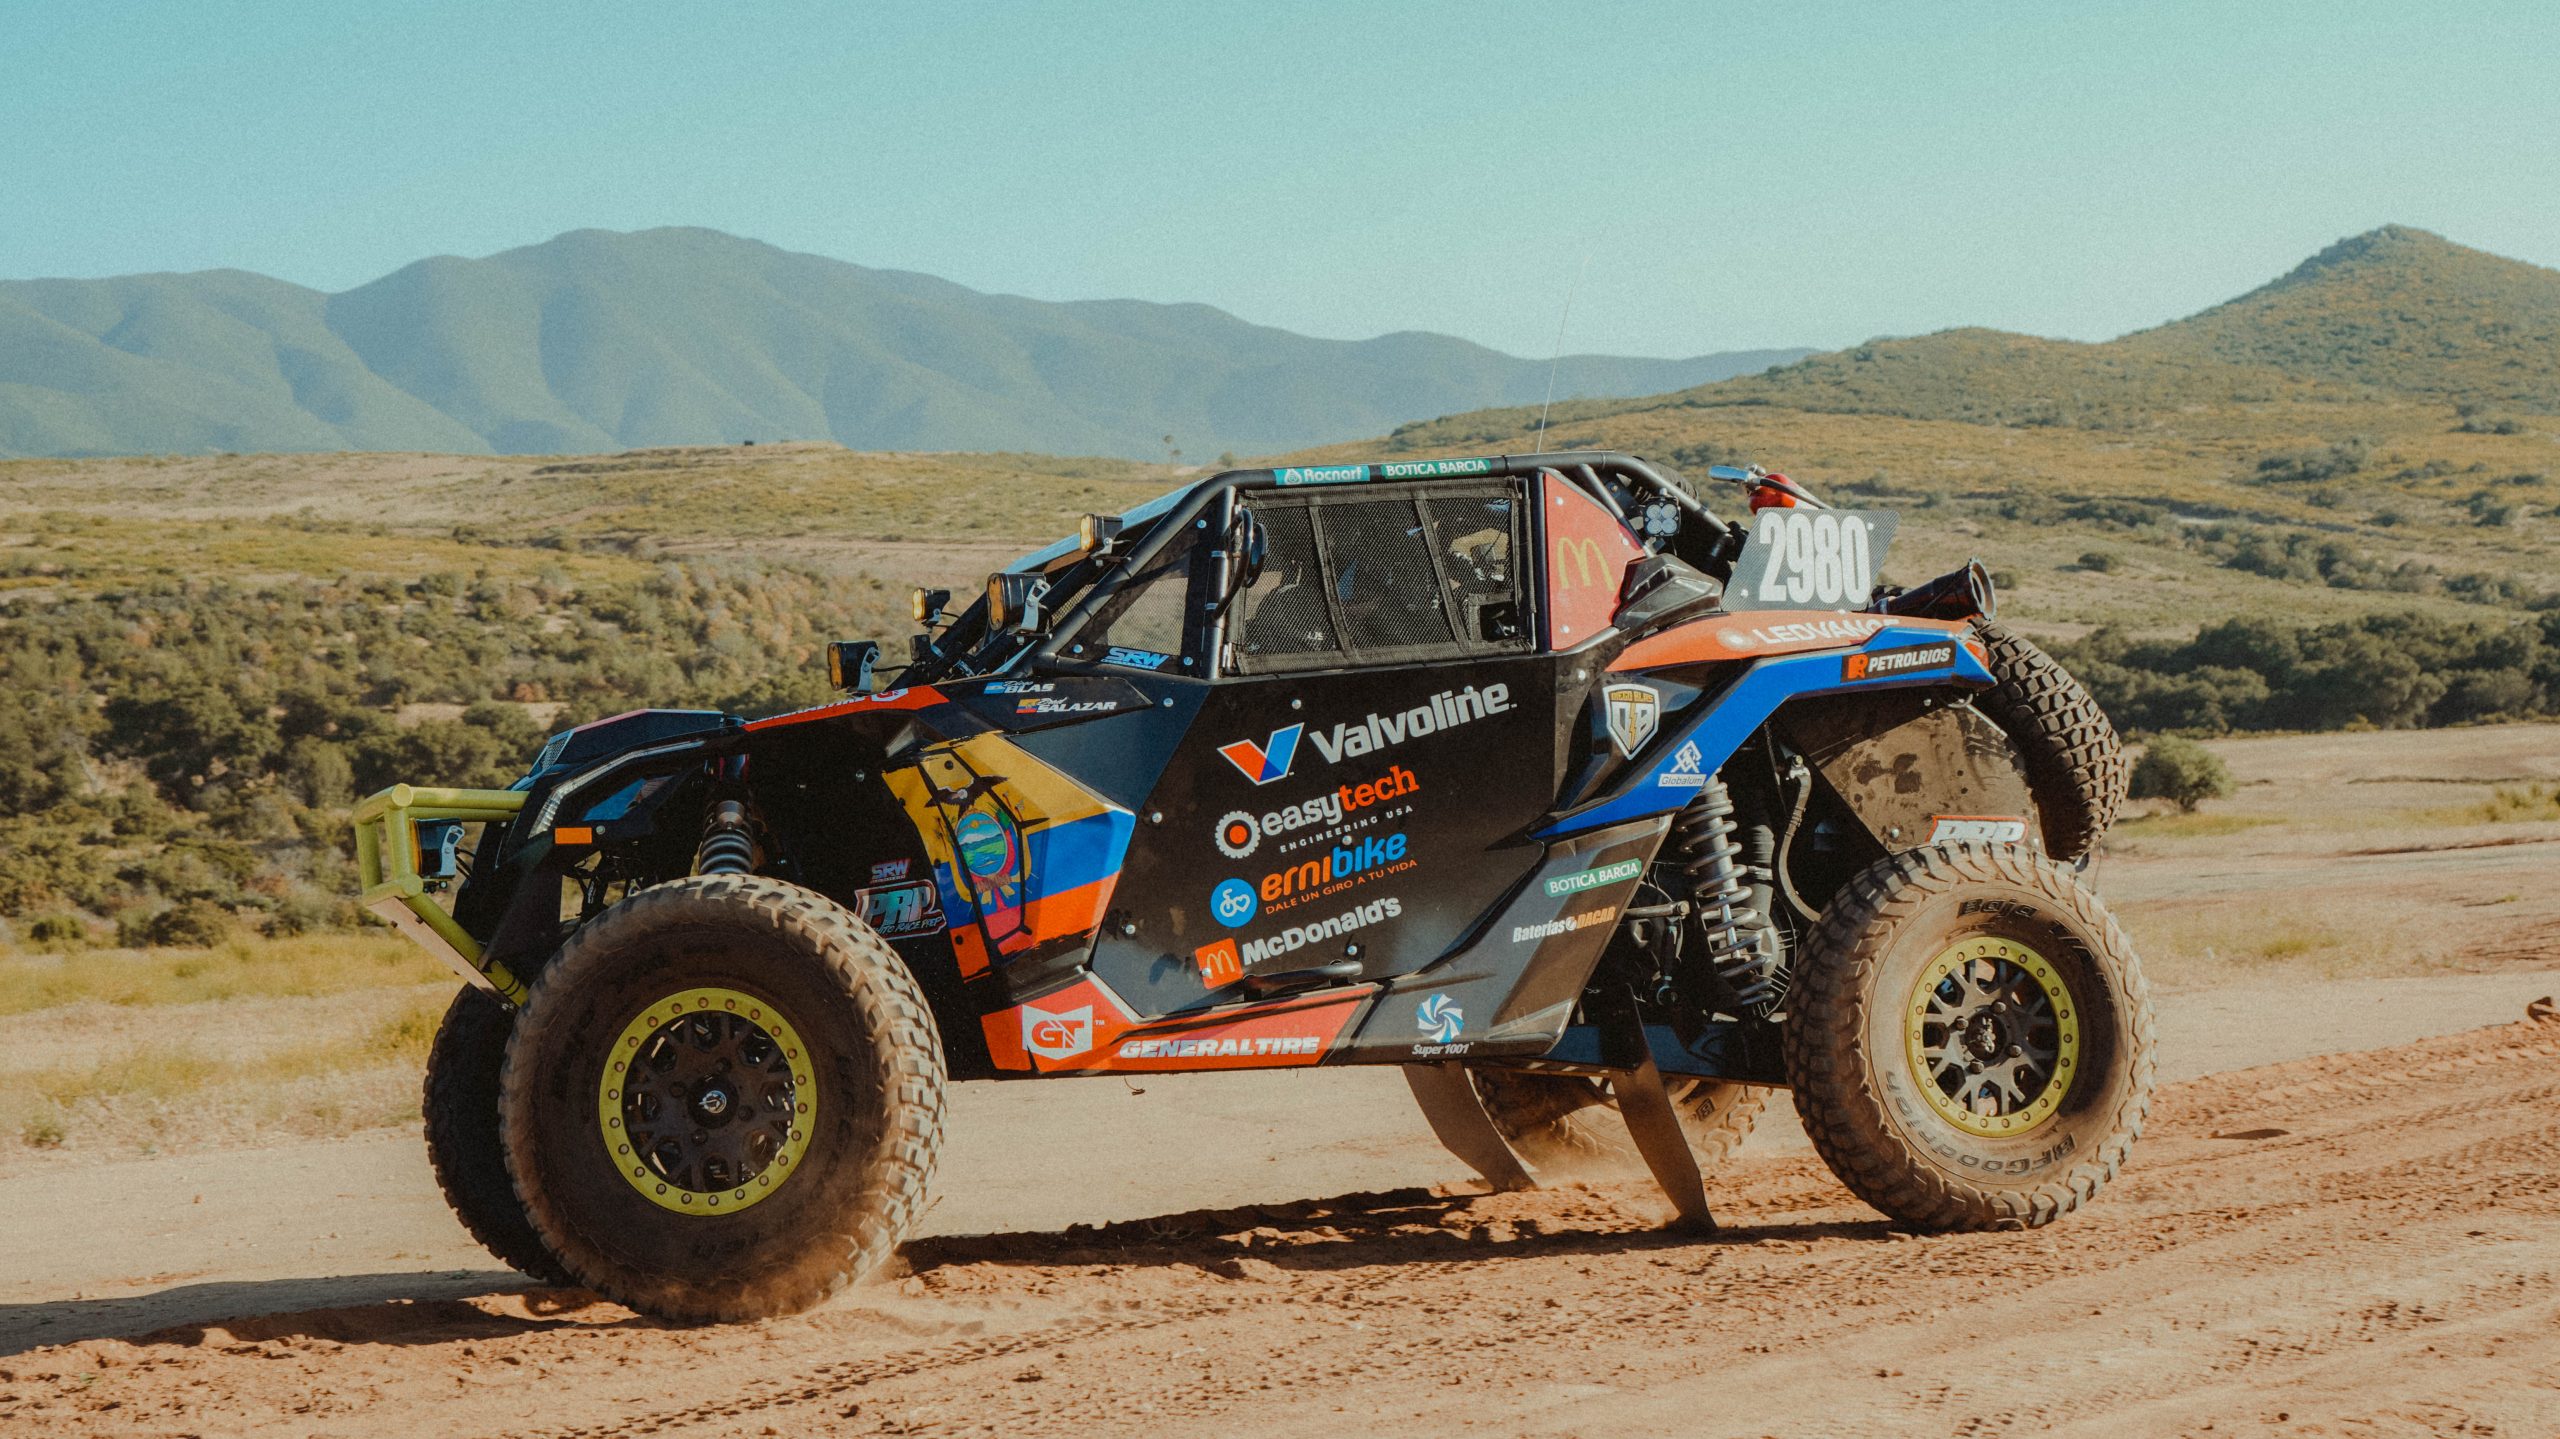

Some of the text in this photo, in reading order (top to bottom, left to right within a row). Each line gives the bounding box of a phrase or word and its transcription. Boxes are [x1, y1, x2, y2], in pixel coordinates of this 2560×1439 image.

[1386, 460, 1487, 477] BOTICA BARCIA
[1759, 511, 1871, 604] 2980
[1753, 618, 1900, 644] LEDVANC
[1868, 647, 1951, 673] PETROLRIOS
[1004, 683, 1056, 694] BLAS
[1037, 701, 1118, 713] SALAZAR
[1309, 682, 1509, 764] Valvoline
[1661, 776, 1703, 785] Globalum
[1261, 765, 1420, 836] easytech
[1280, 805, 1414, 853] ENGINEERING USA
[1266, 859, 1418, 915] DALE UN GIRO A TU VIDA
[1550, 862, 1639, 894] BOTICA BARCIA
[1241, 897, 1402, 965] McDonald's
[1031, 1019, 1087, 1049] GT
[1412, 1043, 1469, 1058] Super 1001
